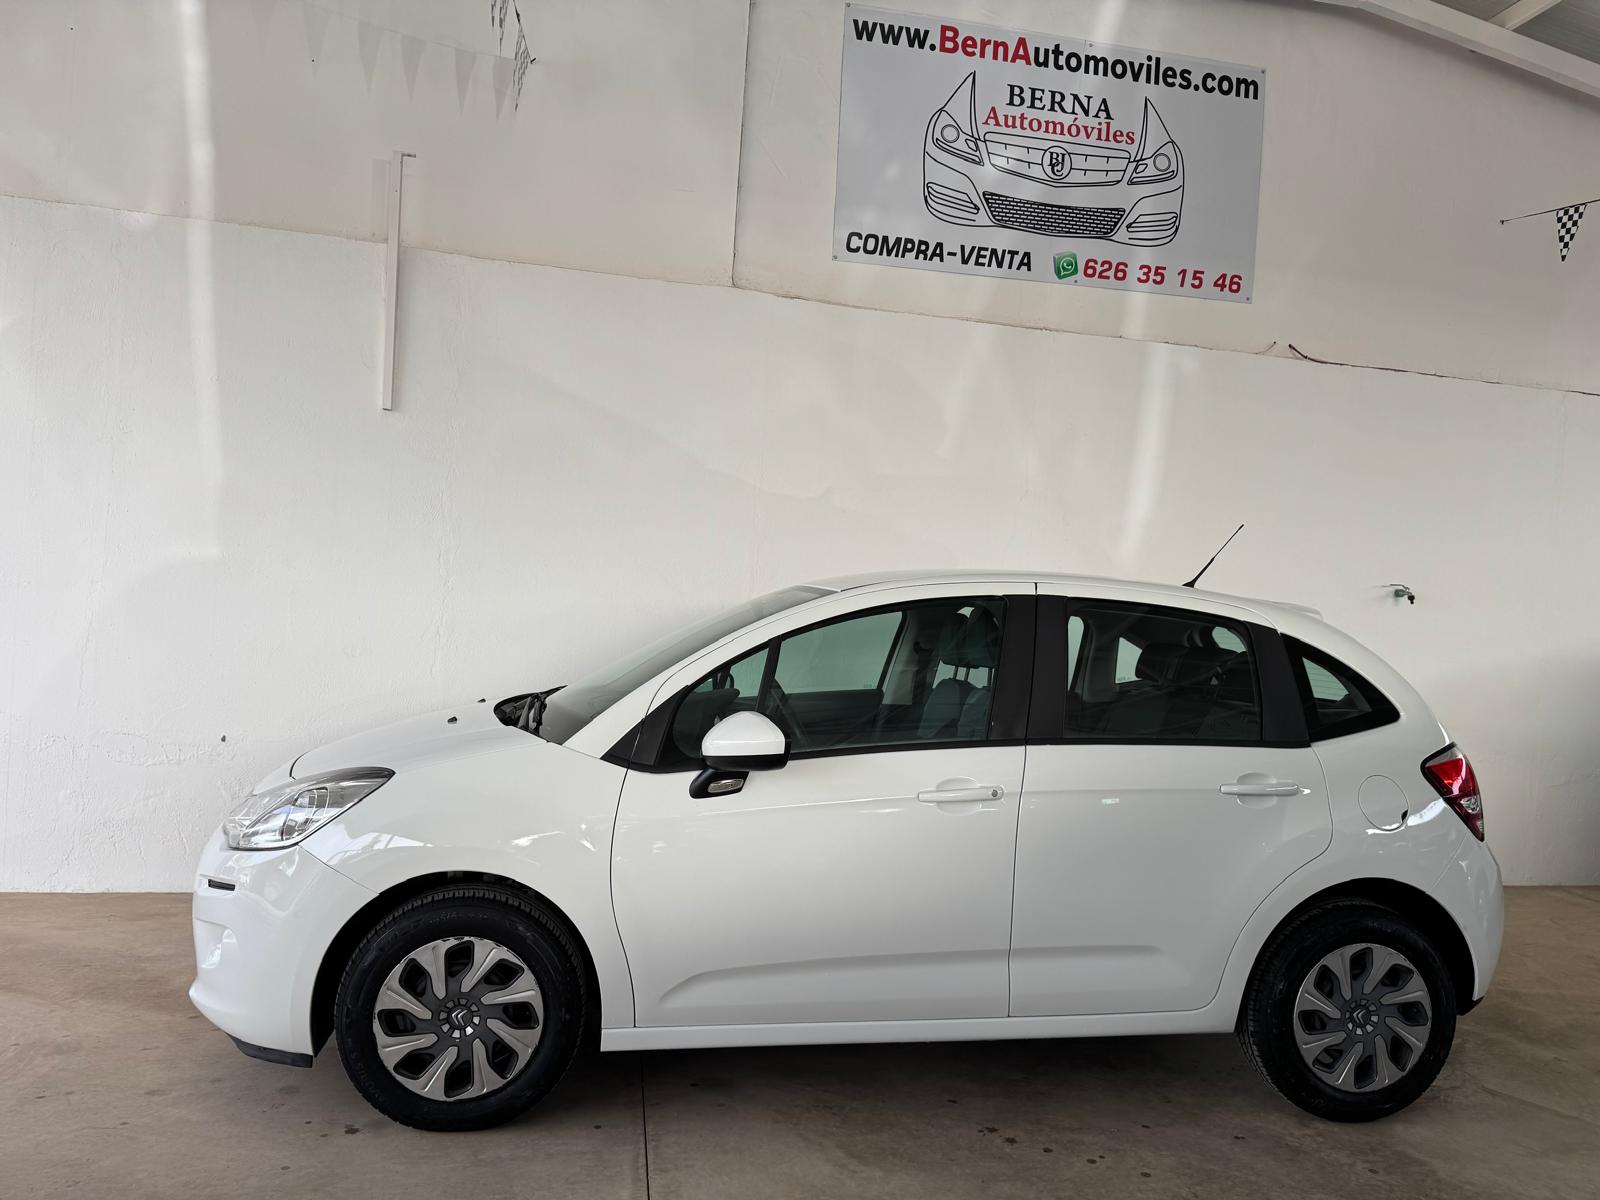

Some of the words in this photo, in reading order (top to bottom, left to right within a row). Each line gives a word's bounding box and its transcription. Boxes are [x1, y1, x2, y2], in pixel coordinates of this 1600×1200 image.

[852, 18, 1259, 101] www.BernAutomoviles.com
[1006, 83, 1115, 121] BERNA
[981, 106, 1136, 145] Automóviles
[845, 231, 1033, 273] COMPRA-VENTA
[1083, 258, 1129, 282] 626
[1136, 264, 1167, 286] 35
[1176, 268, 1205, 290] 15
[1212, 272, 1243, 294] 46
